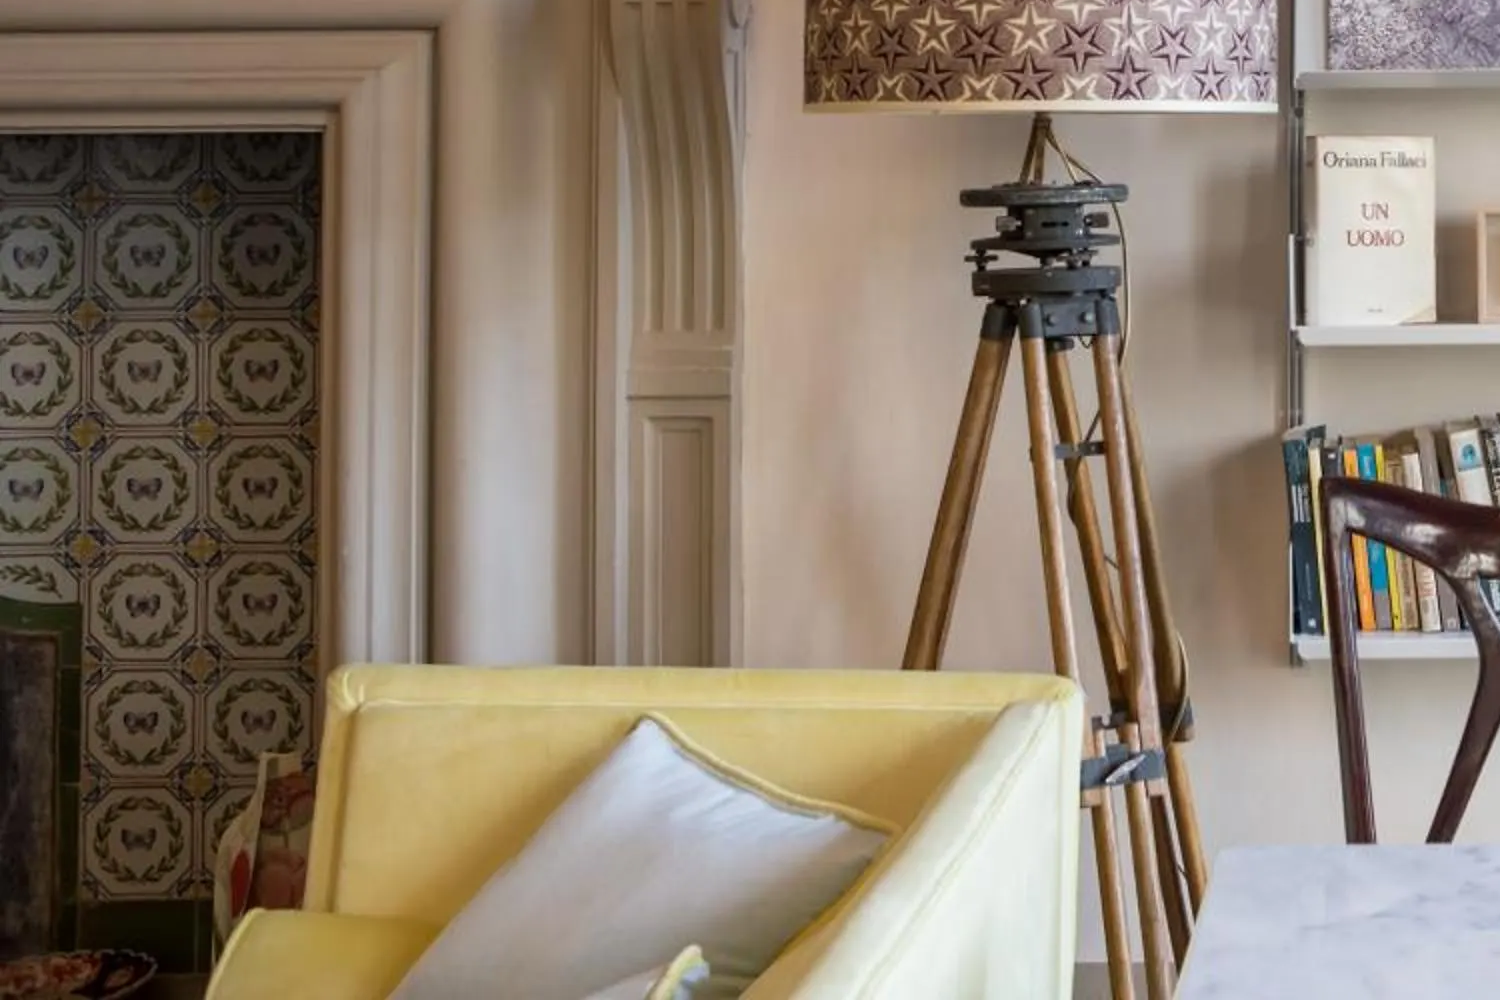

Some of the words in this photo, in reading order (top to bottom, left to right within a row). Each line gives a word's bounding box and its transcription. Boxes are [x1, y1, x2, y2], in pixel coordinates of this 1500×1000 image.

[1323, 151, 1377, 168] Oriana
[1380, 151, 1427, 168] Fallaci
[1361, 202, 1389, 221] UN
[1346, 229, 1405, 247] UOMO
